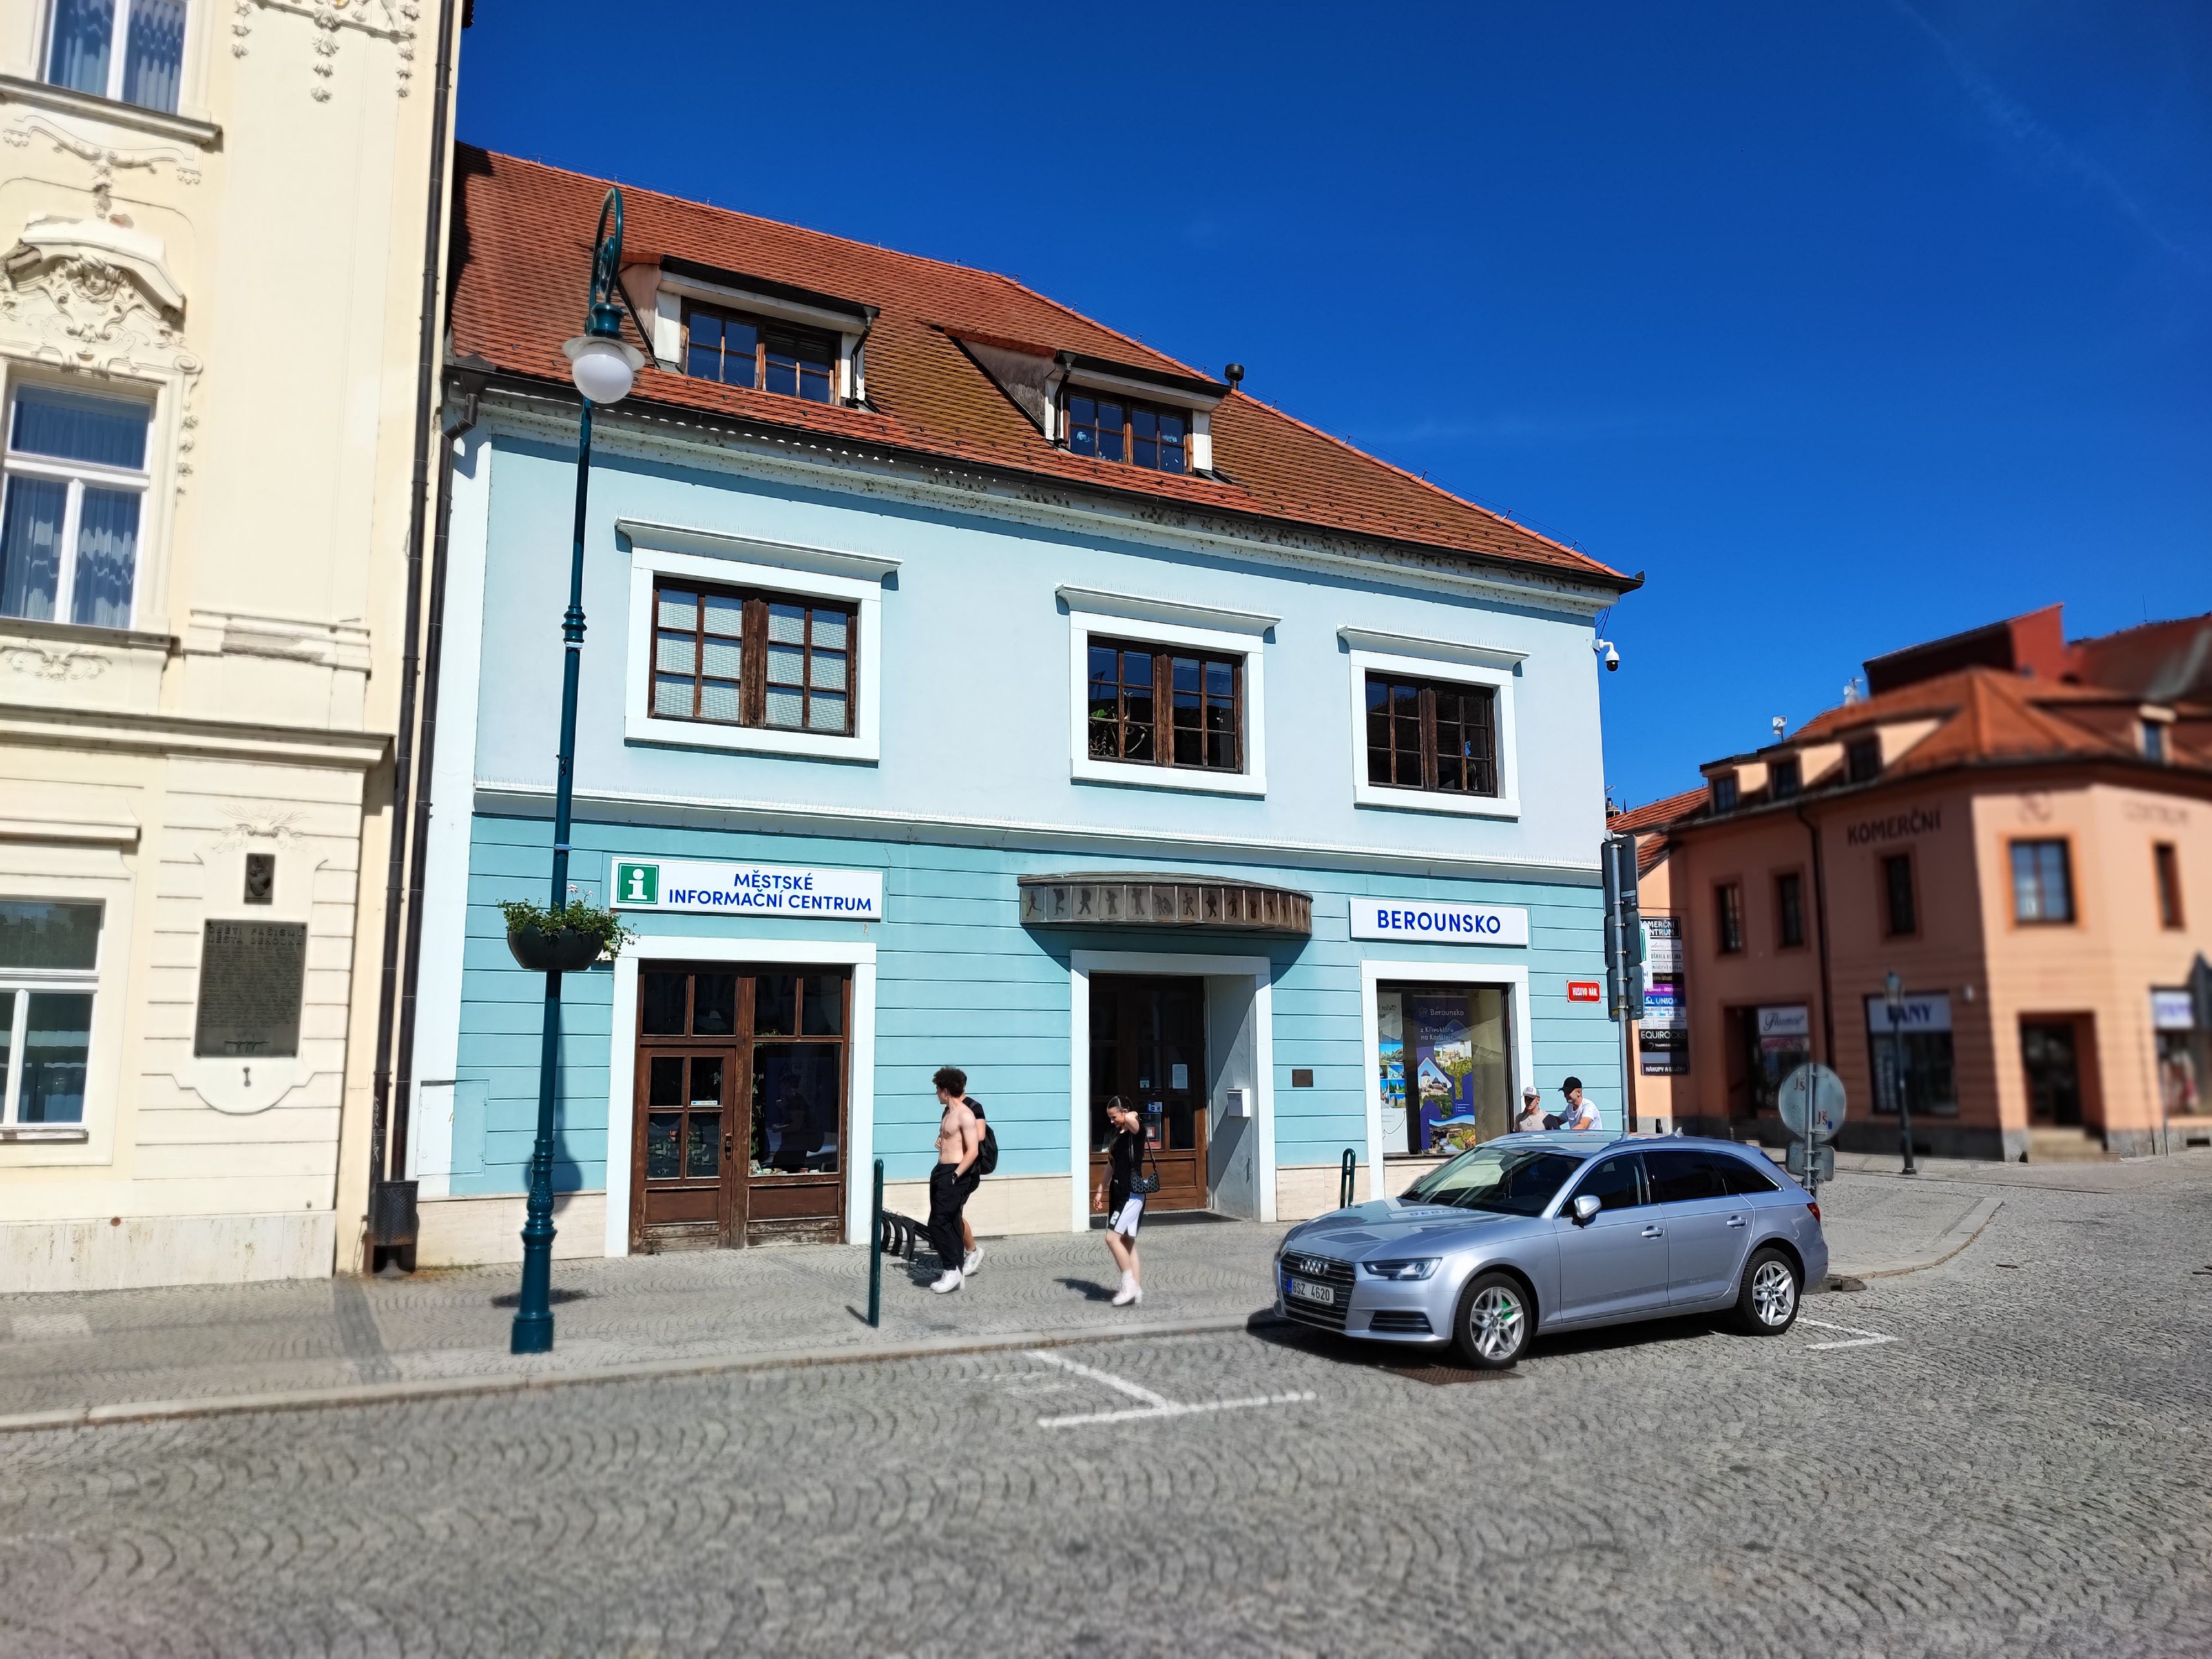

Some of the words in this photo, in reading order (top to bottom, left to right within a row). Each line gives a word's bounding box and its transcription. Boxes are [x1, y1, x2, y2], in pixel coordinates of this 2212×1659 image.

[1847, 805, 1942, 846] KOMERČNÍ
[734, 870, 813, 890] MĚSTSKÉ
[669, 889, 784, 908] INFORMAČNÍ
[788, 895, 872, 911] CENTRUM
[1377, 909, 1501, 934] BEROUNSKO
[1572, 987, 1588, 996] HUSOVO
[1588, 985, 1598, 997] NÁM.
[1641, 1031, 1686, 1039] EQUIROCKS
[1292, 1281, 1306, 1296] 6SZ
[1311, 1285, 1330, 1301] 4620
